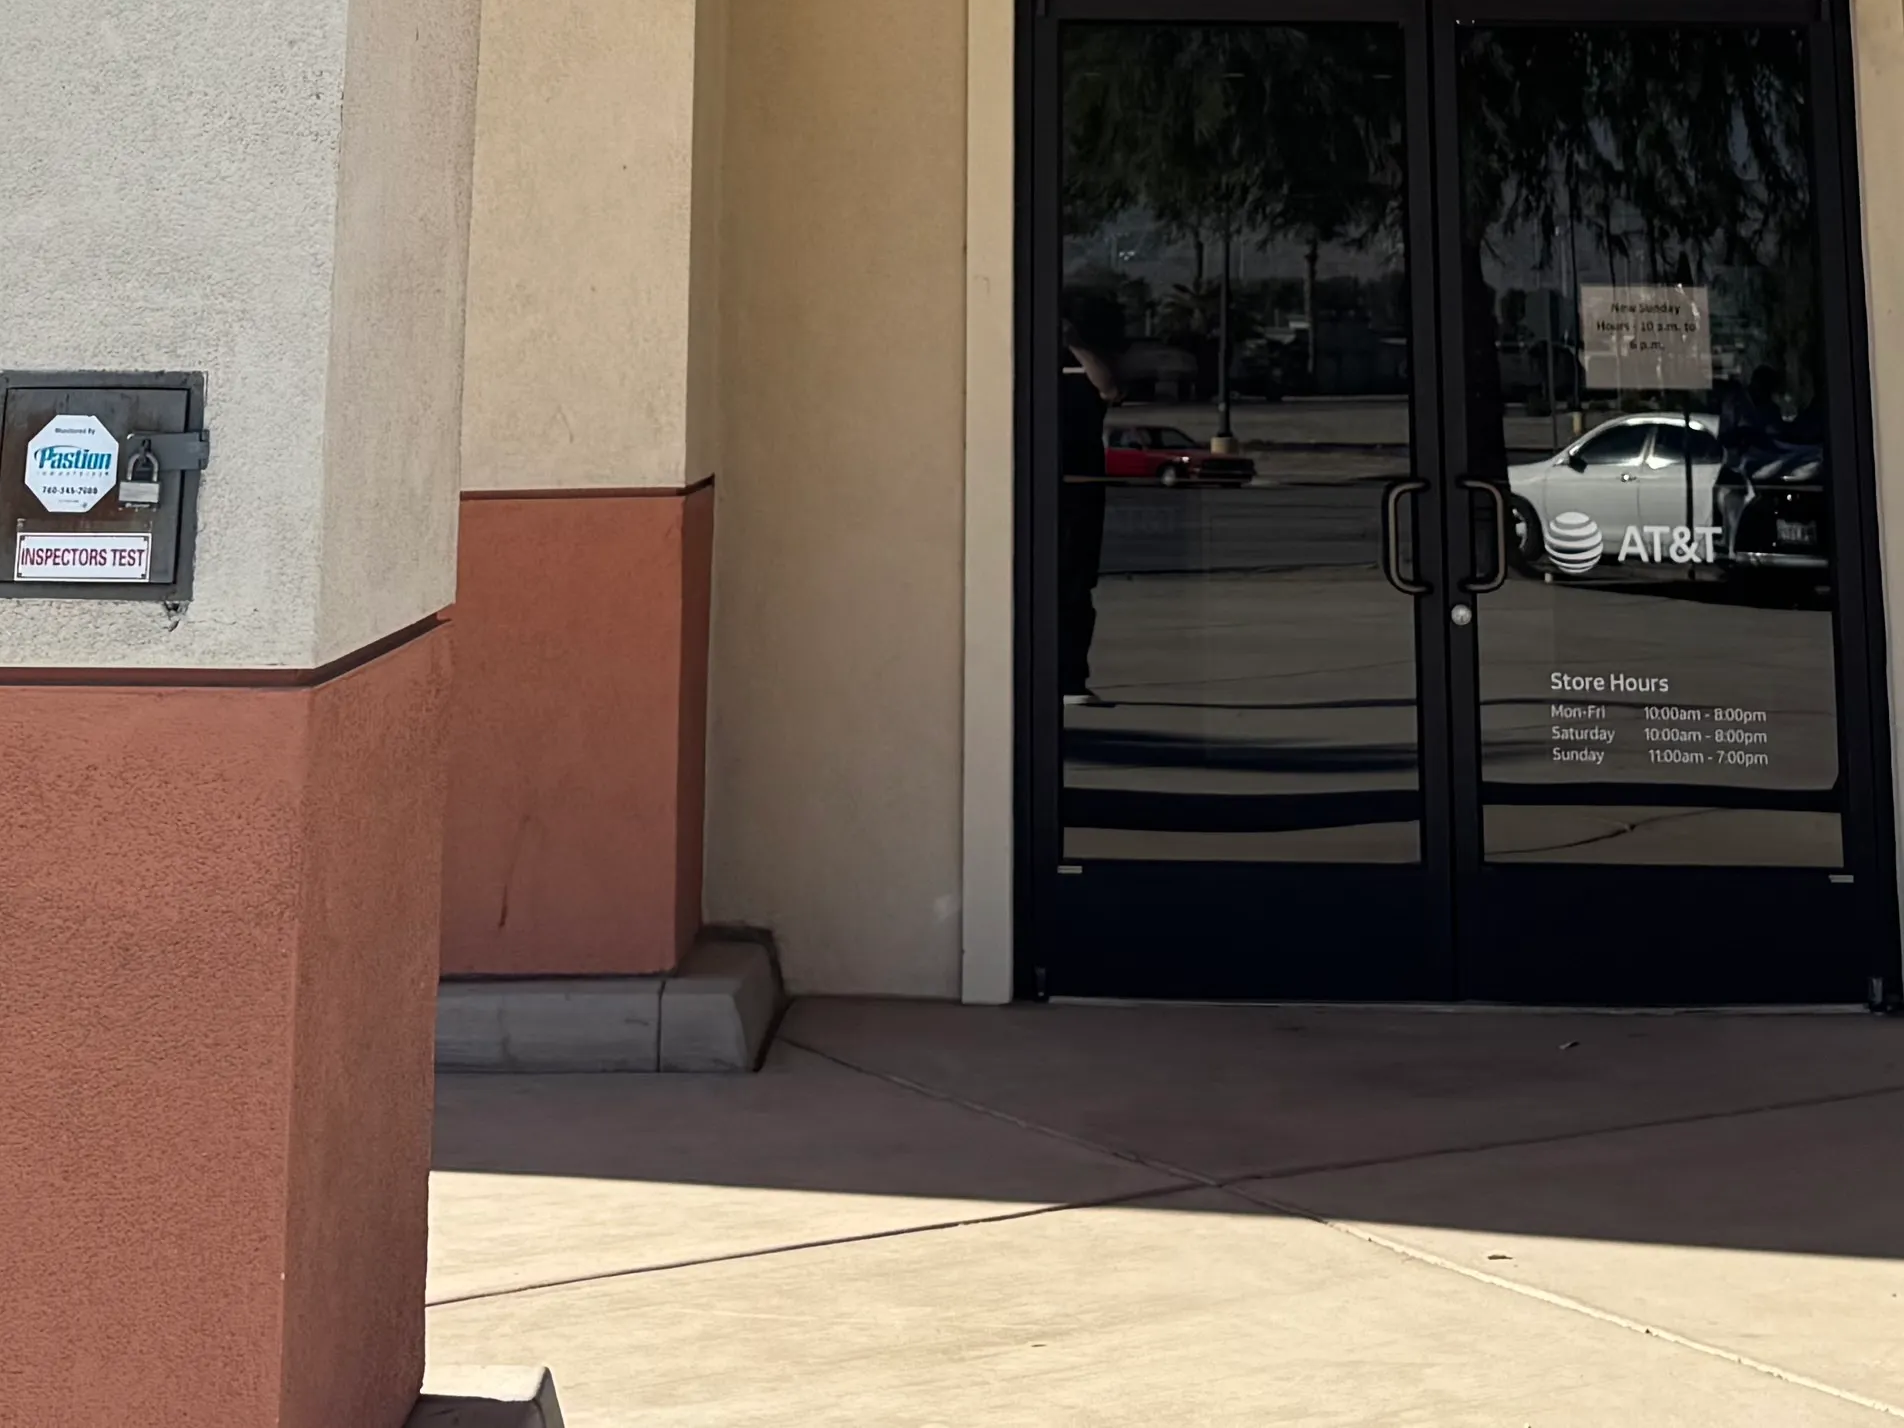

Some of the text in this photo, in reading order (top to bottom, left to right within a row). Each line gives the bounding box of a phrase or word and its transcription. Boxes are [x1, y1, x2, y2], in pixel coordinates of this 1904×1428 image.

[1639, 302, 1681, 315] Sunday
[1597, 320, 1629, 332] Hours
[1641, 321, 1653, 332] 10
[1684, 322, 1697, 333] to
[35, 444, 113, 470] Pastion
[1618, 525, 1723, 564] AT&T
[20, 546, 146, 567] INSPECTORS TEST
[1550, 672, 1669, 692] Store Hours
[1550, 705, 1606, 719] Mon-Fri
[1644, 706, 1701, 721] 10:00am
[1714, 708, 1767, 725] 8:00pm
[1552, 726, 1616, 744] Saturday
[1644, 728, 1702, 743] 10:00am
[1714, 729, 1768, 746] 8:00pm
[1552, 747, 1605, 765] Sunday
[1648, 749, 1704, 764] 11:00am
[1716, 750, 1769, 768] 7:00pm
